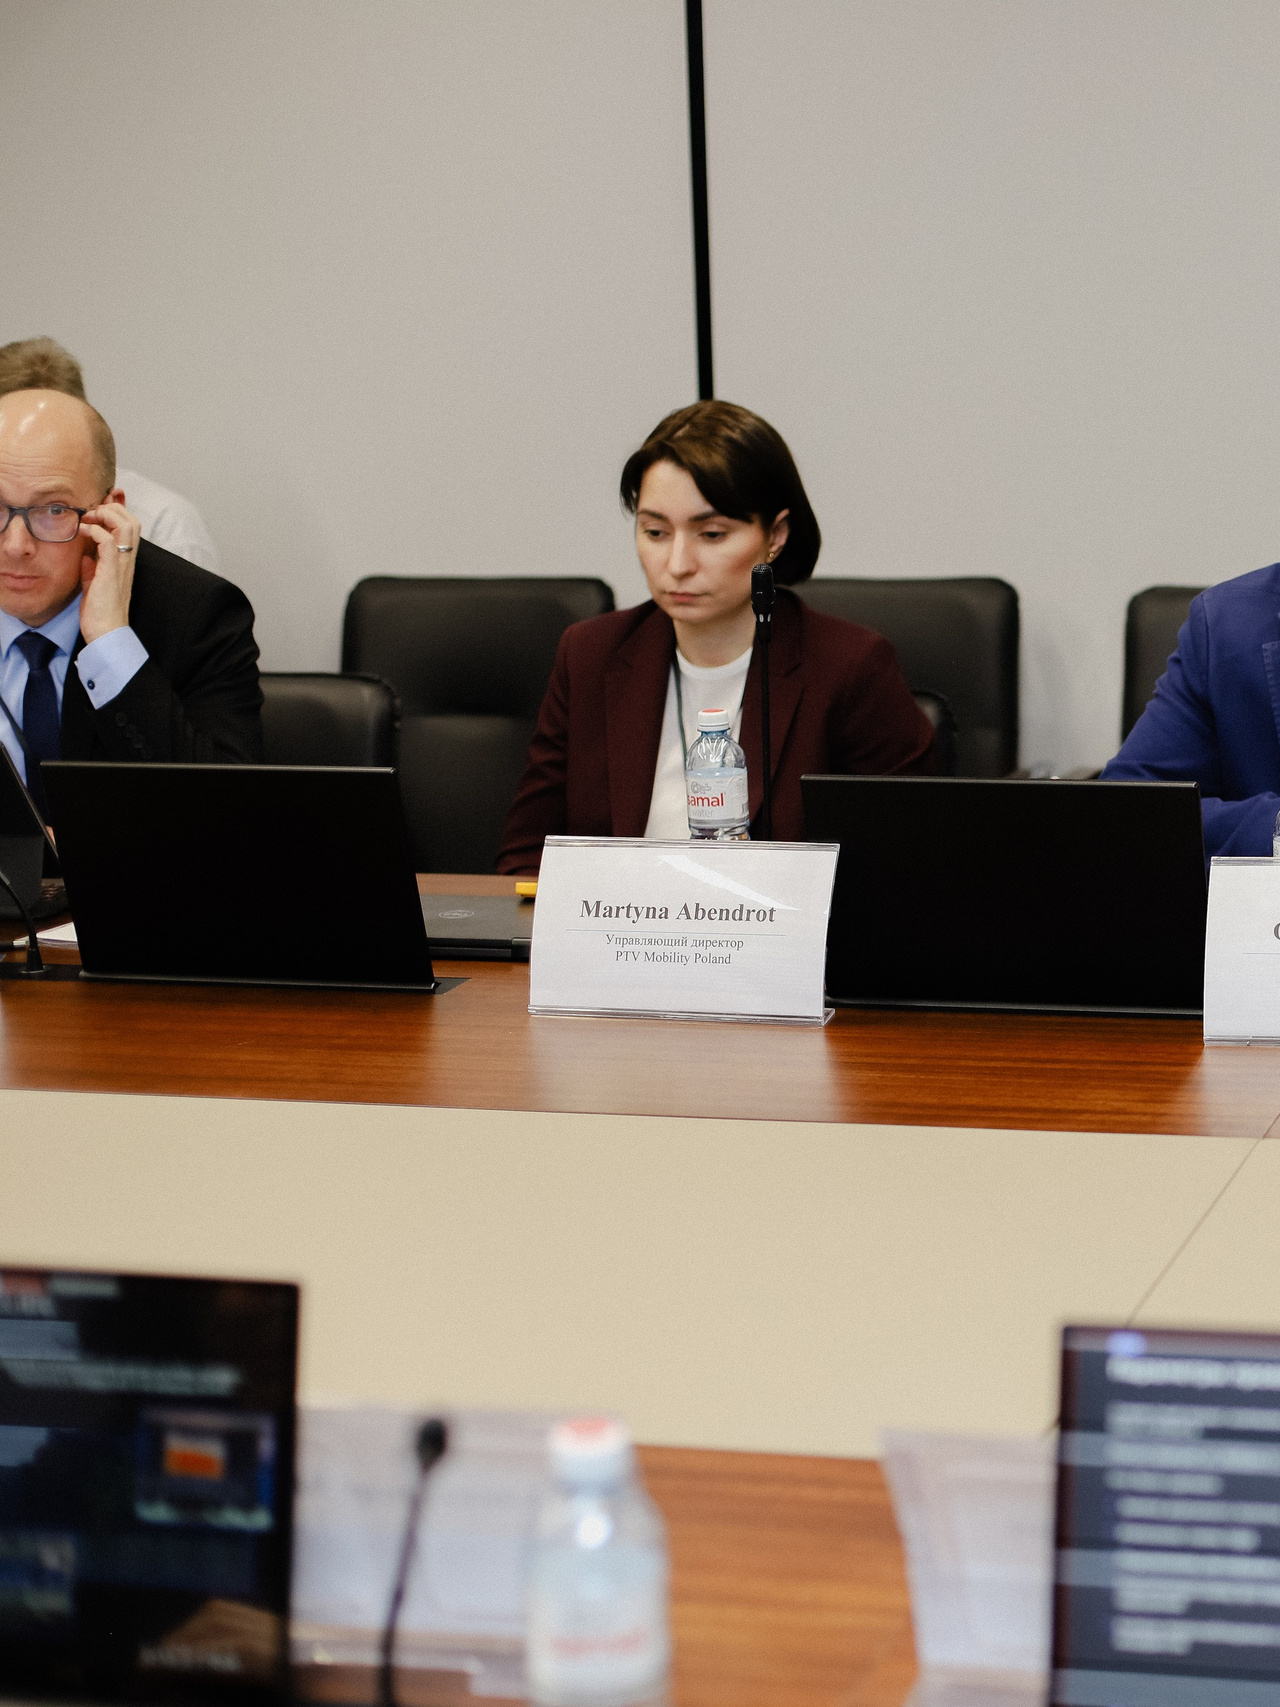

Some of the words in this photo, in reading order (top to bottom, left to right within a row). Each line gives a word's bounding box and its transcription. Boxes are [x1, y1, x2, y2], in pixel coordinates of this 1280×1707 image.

[579, 900, 670, 924] Martyna
[675, 902, 777, 923] Abendrot
[605, 934, 688, 949] Управляющий
[691, 938, 744, 951] директор
[615, 951, 641, 963] PTV
[644, 952, 691, 966] Mobility
[694, 953, 732, 965] Poland
